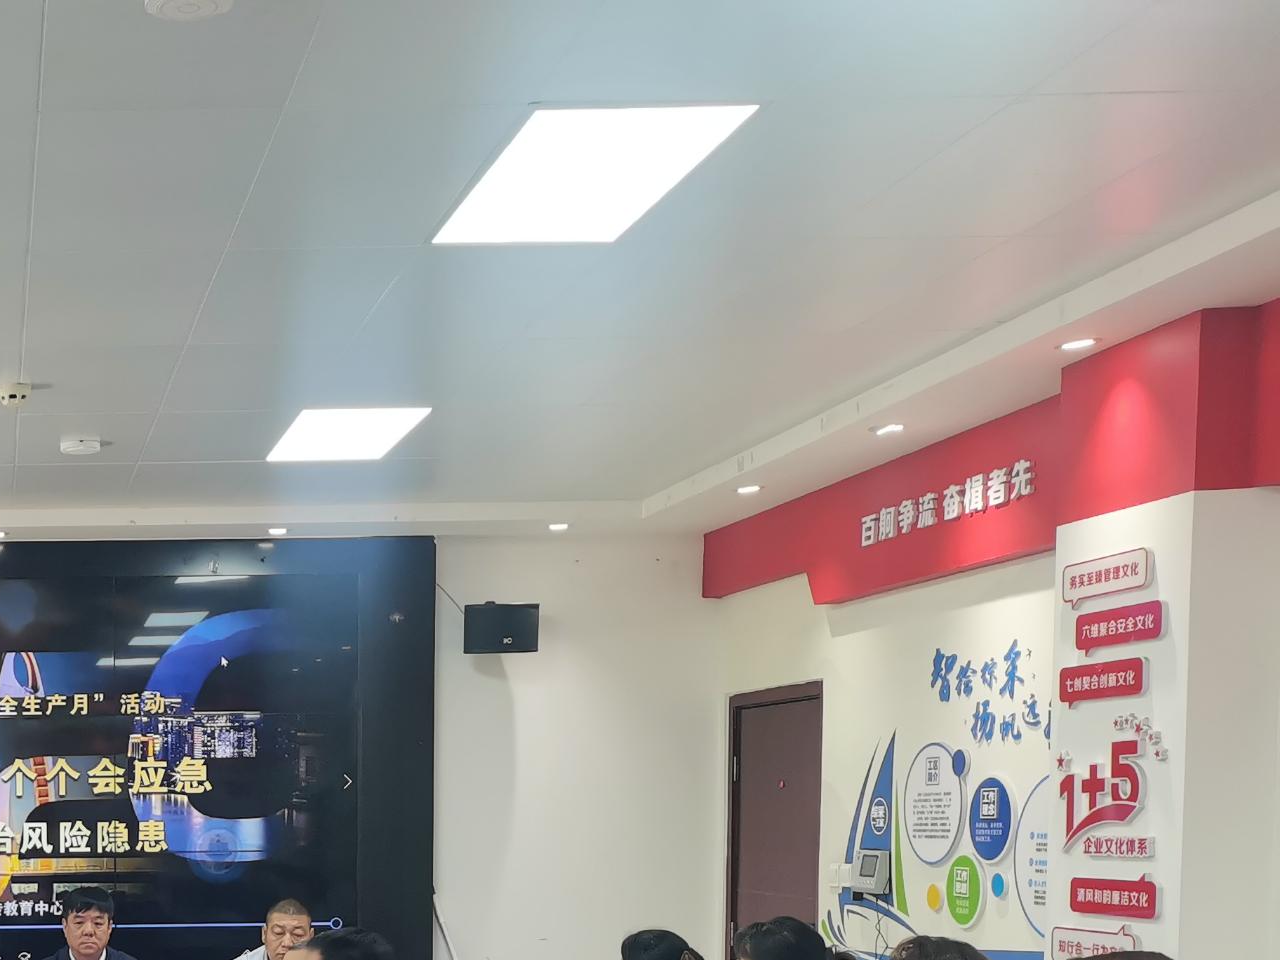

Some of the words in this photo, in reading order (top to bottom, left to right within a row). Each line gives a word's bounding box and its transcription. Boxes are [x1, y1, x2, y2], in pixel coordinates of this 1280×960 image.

[861, 493, 938, 547] 百舸争流
[943, 459, 1033, 521] 奋楫者先
[0, 757, 214, 798] 个个会应急
[1060, 740, 1140, 838] 1+5
[1083, 838, 1147, 855] 企业文化体系
